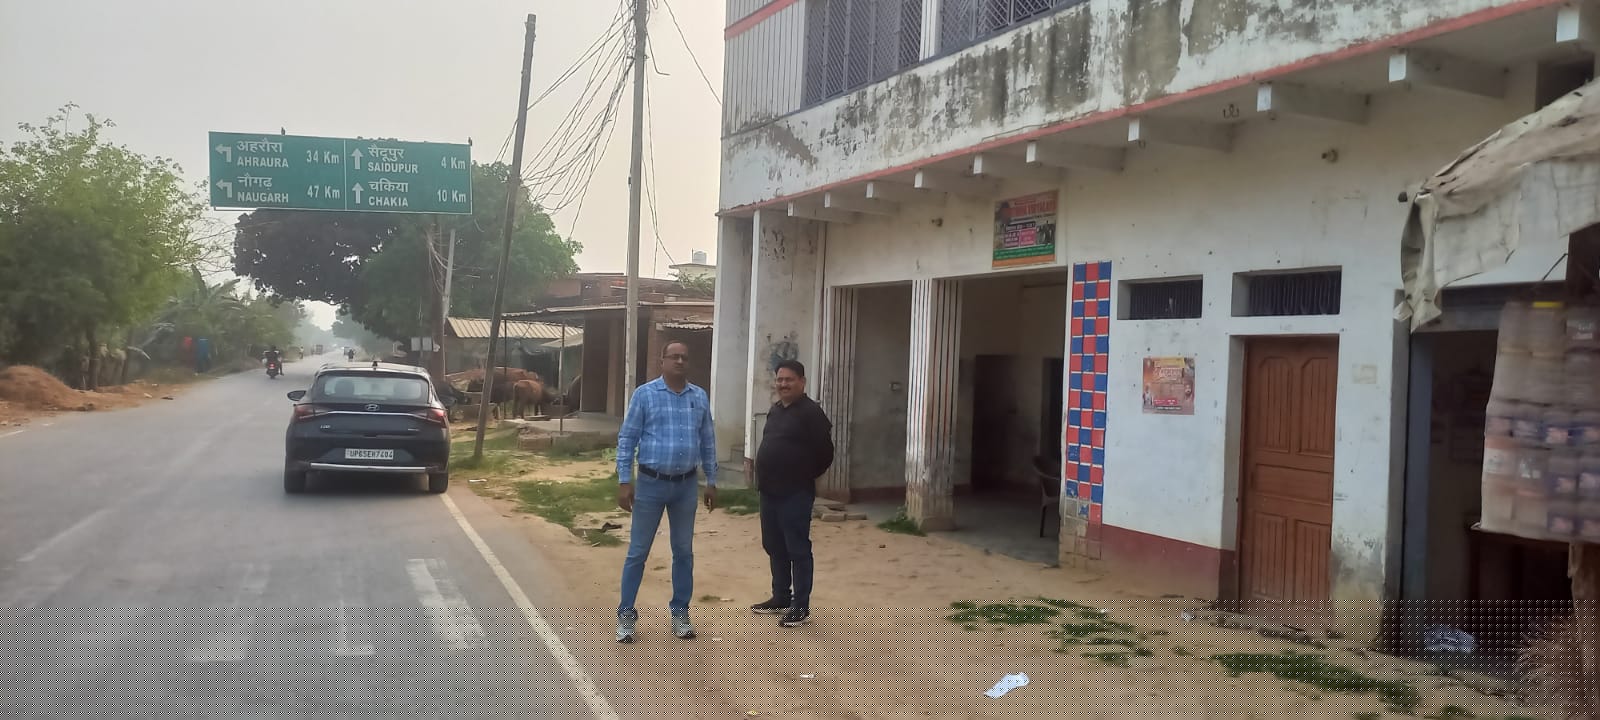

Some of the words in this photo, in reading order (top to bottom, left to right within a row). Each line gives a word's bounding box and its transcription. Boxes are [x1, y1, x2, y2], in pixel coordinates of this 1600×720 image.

[237, 137, 283, 153] अहरौरा
[306, 150, 319, 163] 34
[324, 151, 340, 164] Km
[367, 143, 405, 162] सैदूपुर
[237, 156, 289, 168] AHRAURA
[367, 161, 418, 174] SAIDUPUR
[441, 156, 447, 169] 4
[450, 157, 466, 170] Km
[367, 177, 409, 192] चकिया
[237, 191, 289, 203] NAUGARH
[307, 185, 320, 198] 47
[324, 186, 341, 199] Km
[437, 189, 448, 202] 10
[451, 190, 467, 203] Km
[368, 196, 409, 207] CHAKIA
